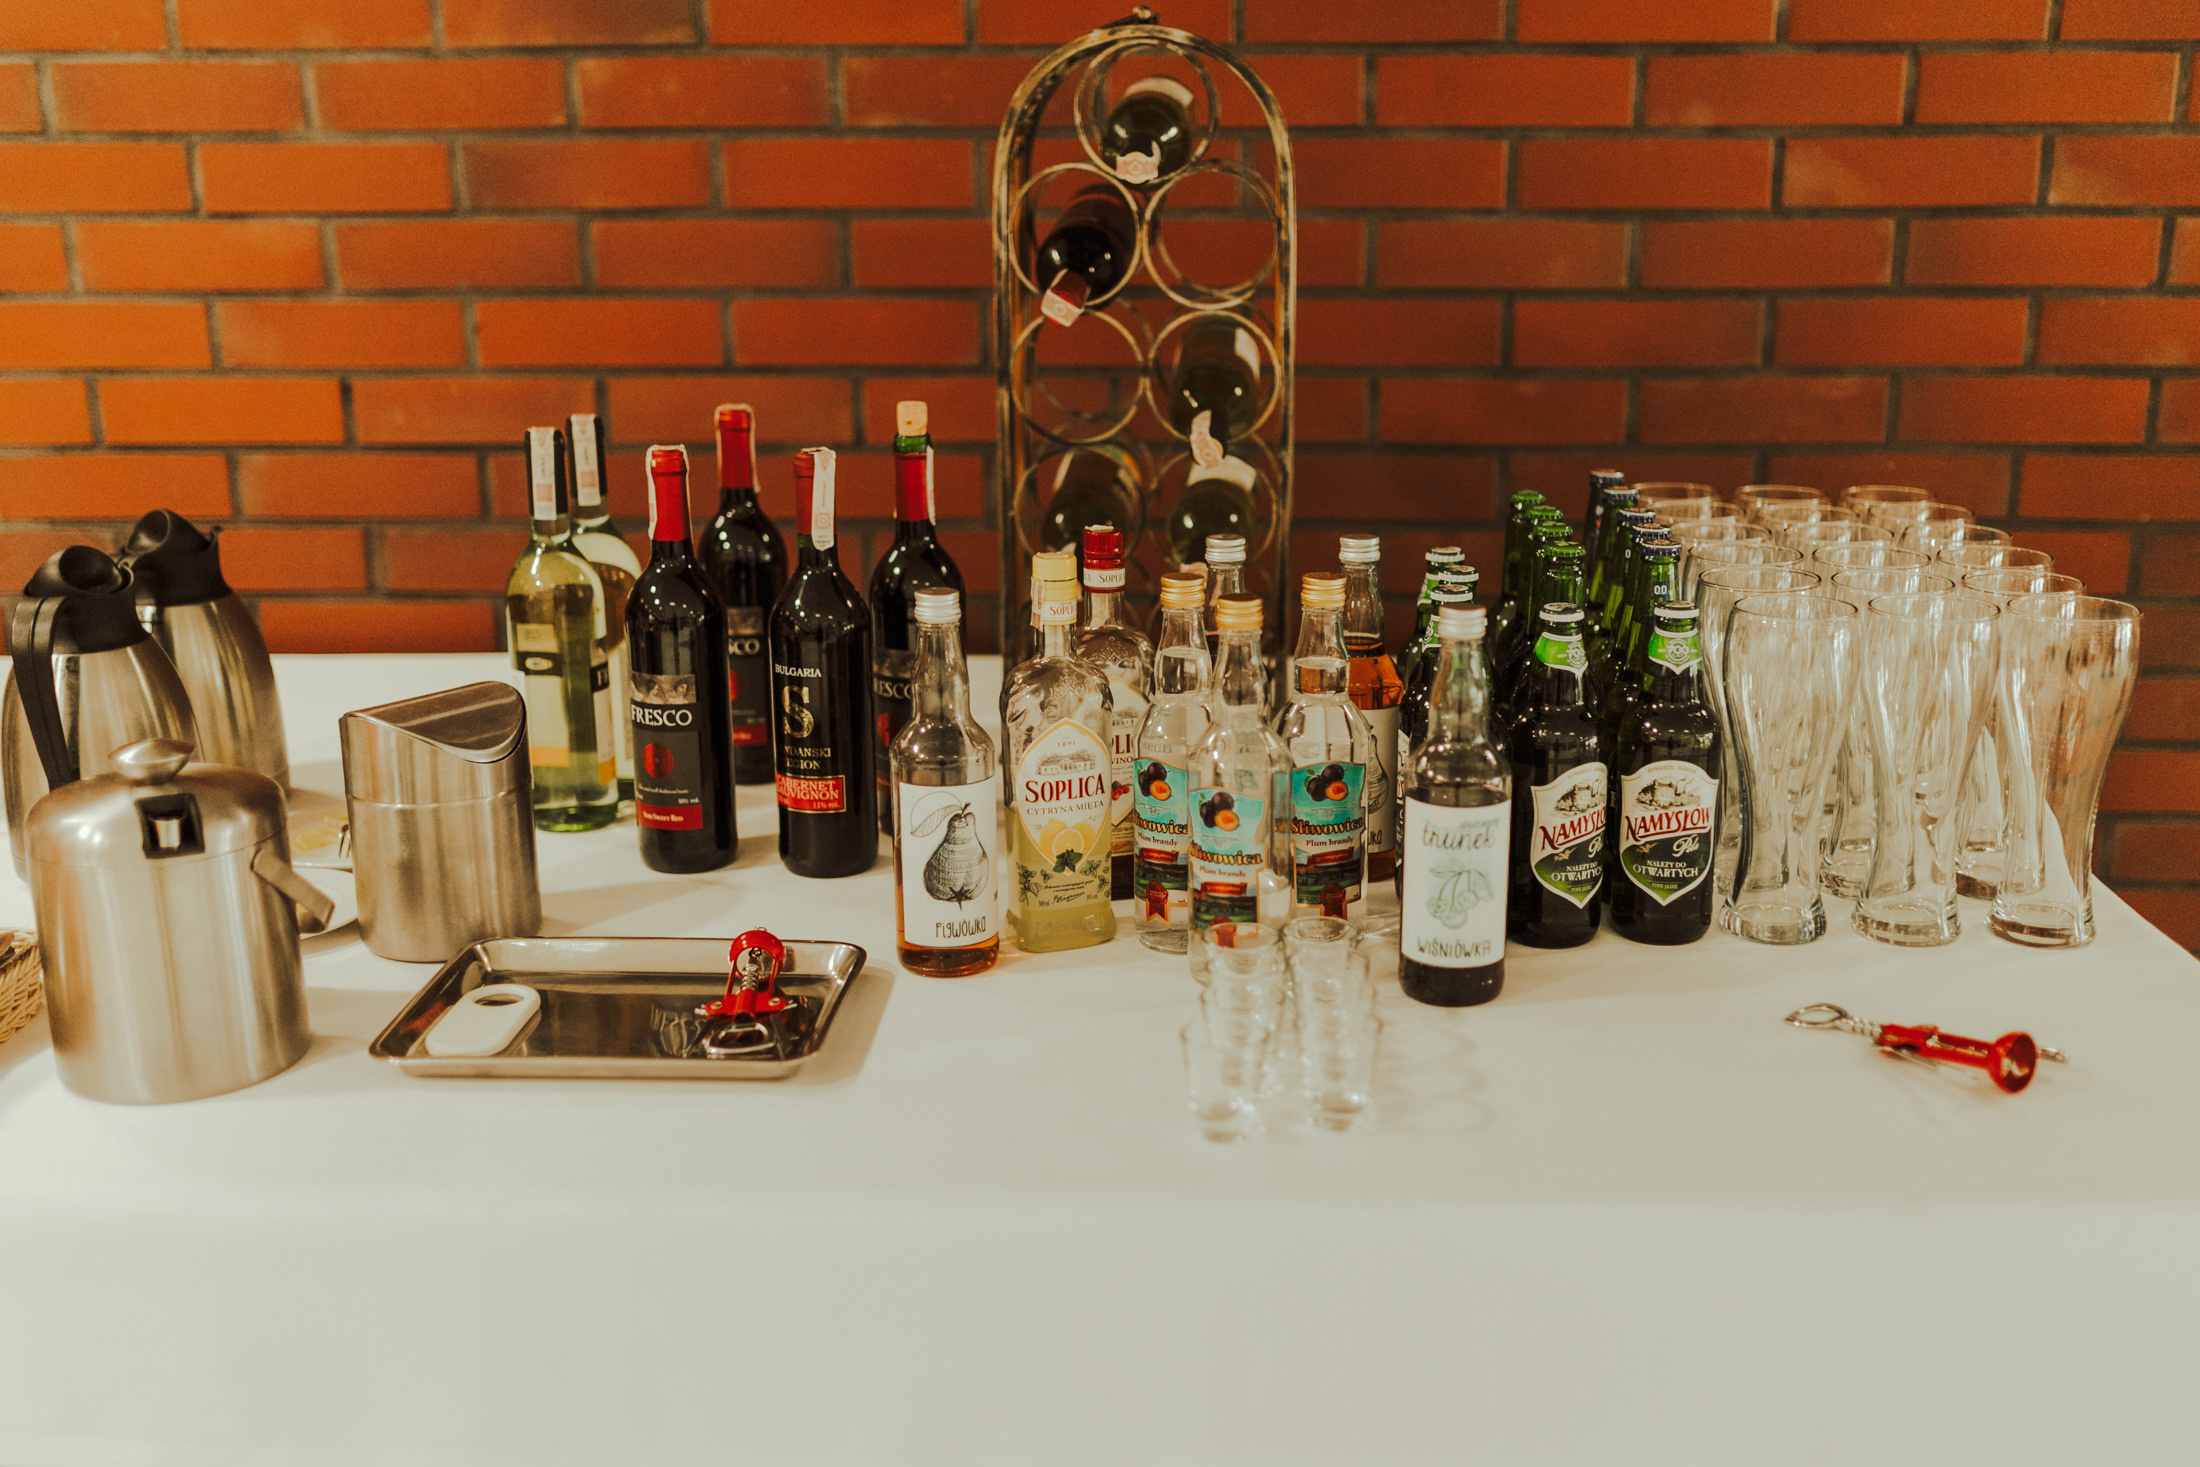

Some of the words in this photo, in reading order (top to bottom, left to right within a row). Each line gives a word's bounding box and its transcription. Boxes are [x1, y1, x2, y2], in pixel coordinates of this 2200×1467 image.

[775, 663, 822, 678] BULGARIA
[631, 704, 693, 727] FRESCO
[783, 685, 814, 738] S
[777, 776, 836, 791] CABERNET
[1025, 772, 1105, 803] SOPLICA
[1291, 816, 1364, 836] Śliwowica
[1138, 832, 1152, 843] Plum
[1152, 835, 1179, 849] brandy
[1306, 839, 1328, 848] Plum
[1329, 836, 1354, 847] brandy
[1672, 834, 1699, 858] Pils
[1199, 866, 1217, 876] Plum
[1218, 867, 1247, 880] brandy
[1632, 863, 1699, 878] OTWARTYCH
[1417, 936, 1491, 959] WIŚNIÓWKA
